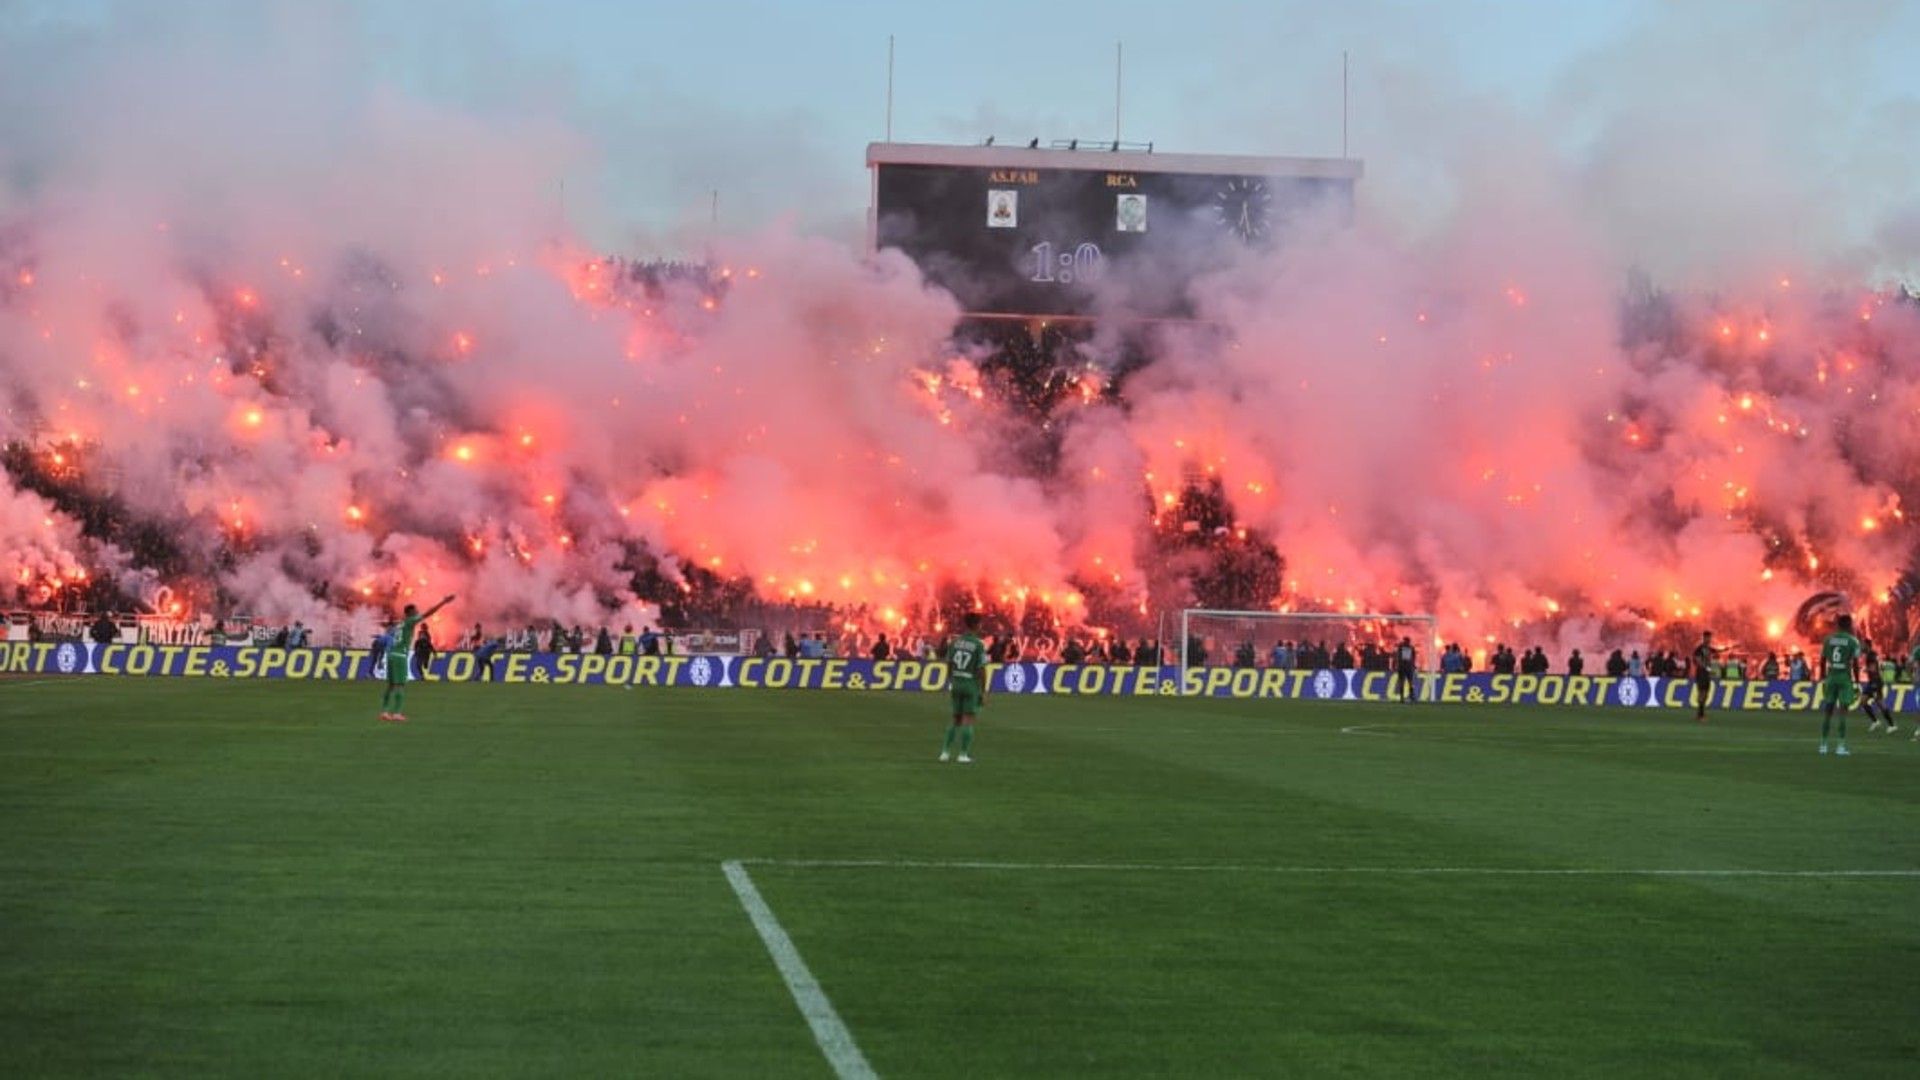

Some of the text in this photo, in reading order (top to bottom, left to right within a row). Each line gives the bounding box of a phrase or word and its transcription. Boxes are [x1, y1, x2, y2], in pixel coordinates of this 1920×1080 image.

[1106, 174, 1137, 188] RCA
[1031, 241, 1102, 284] 1:0
[100, 644, 369, 681] COTE&SPORT
[953, 650, 972, 670] 47
[1832, 646, 1841, 662] 6
[738, 658, 1004, 693] COTE&SPOT
[1053, 665, 1313, 698] COTE&SPORT
